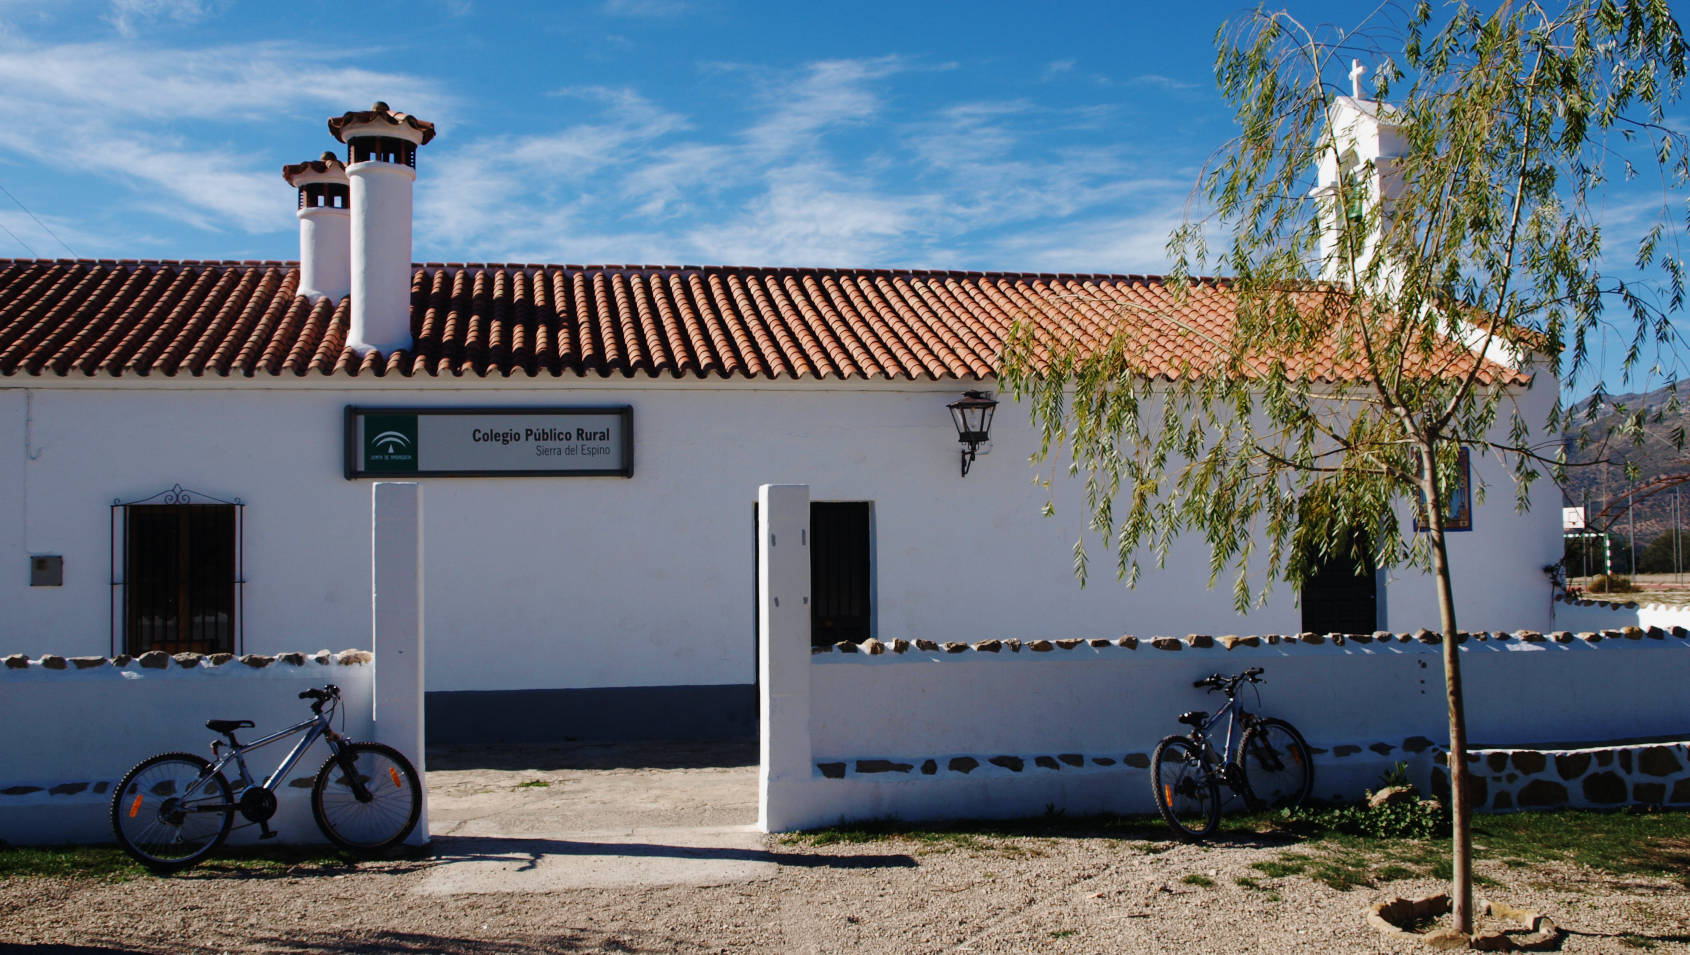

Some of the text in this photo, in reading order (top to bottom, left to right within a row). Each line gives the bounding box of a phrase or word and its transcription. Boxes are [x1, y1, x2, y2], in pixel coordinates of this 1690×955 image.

[472, 427, 610, 445] Colegio Público Rural
[536, 444, 611, 458] Sierra del Espino
